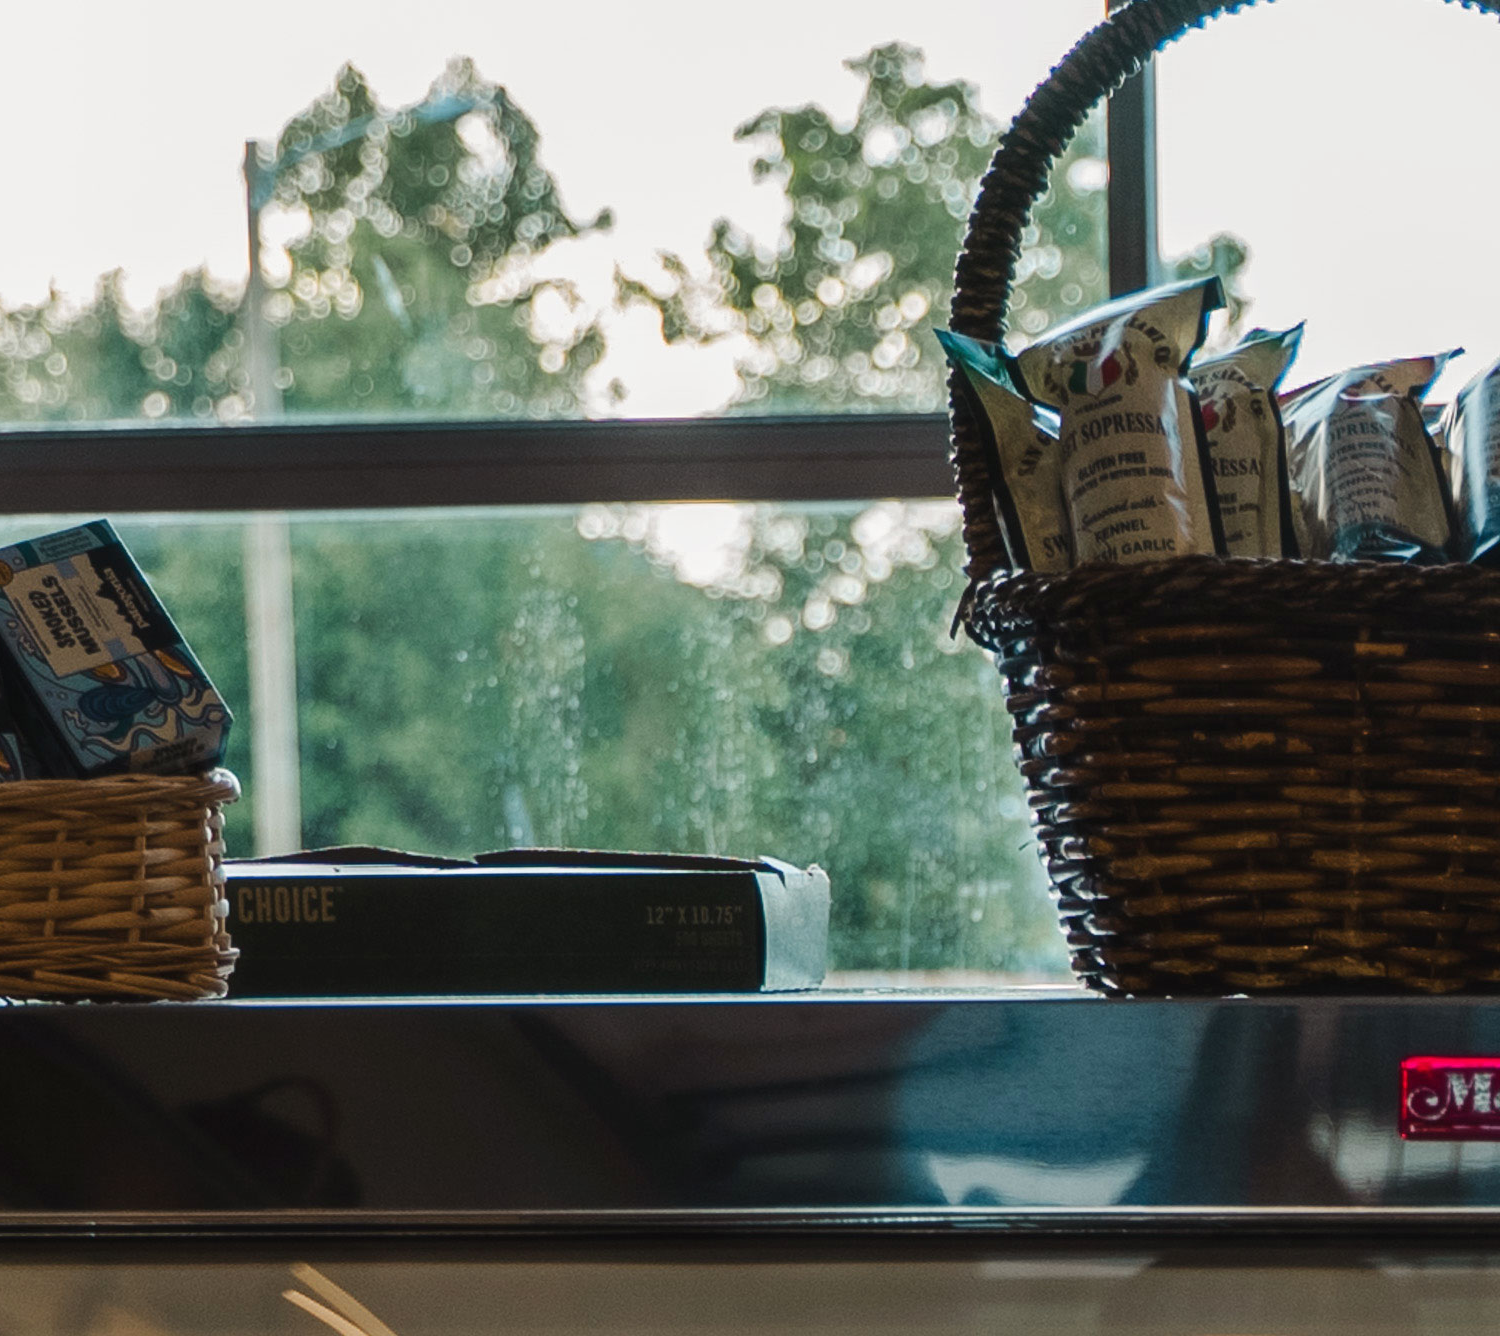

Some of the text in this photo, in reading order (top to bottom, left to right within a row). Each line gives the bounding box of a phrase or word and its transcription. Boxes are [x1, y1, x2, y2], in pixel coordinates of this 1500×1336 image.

[1094, 518, 1150, 543] FENNEL
[1121, 538, 1176, 556] GARLIC
[41, 575, 101, 655] MUSSELS
[103, 566, 150, 630] patagonia
[28, 590, 76, 649] SMOKED
[691, 904, 744, 926] 10.75"
